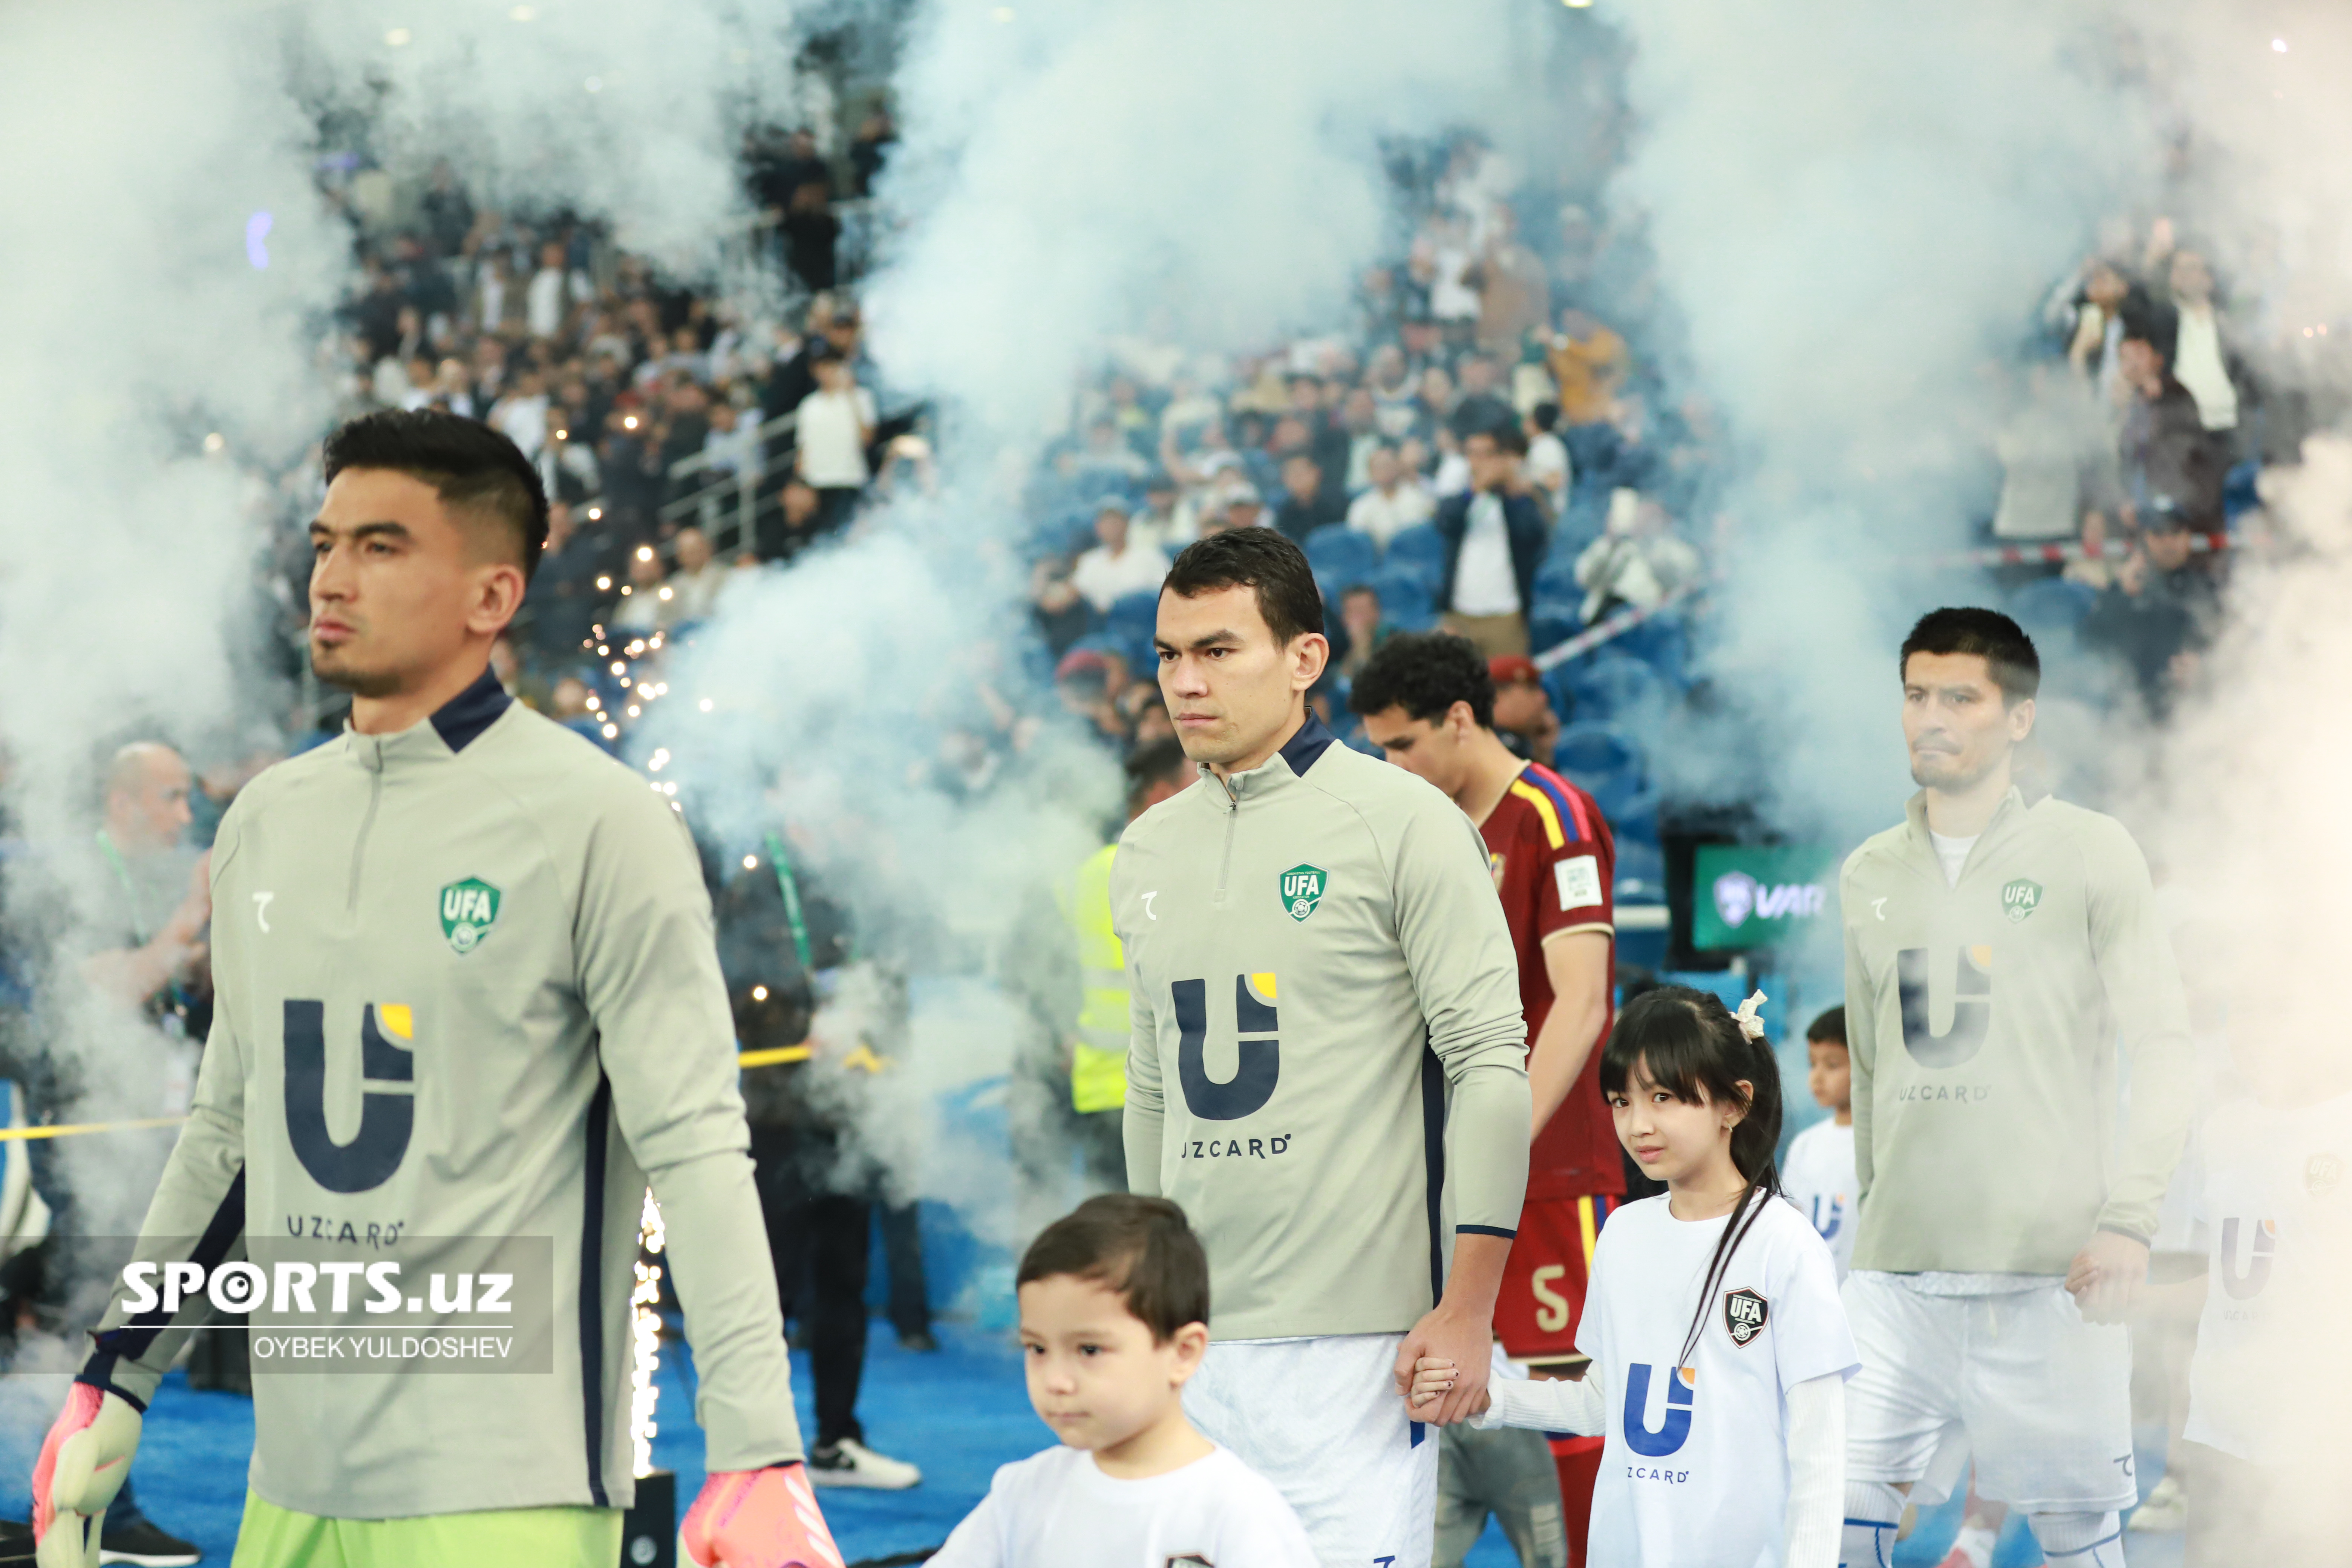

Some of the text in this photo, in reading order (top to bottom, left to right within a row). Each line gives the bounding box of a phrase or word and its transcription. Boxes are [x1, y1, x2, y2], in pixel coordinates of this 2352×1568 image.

[1284, 875, 1319, 897] UFA
[2005, 886, 2034, 905] UFA
[443, 888, 491, 923] UFA
[1756, 884, 1825, 919] VAR
[1730, 1297, 1762, 1322] UFA
